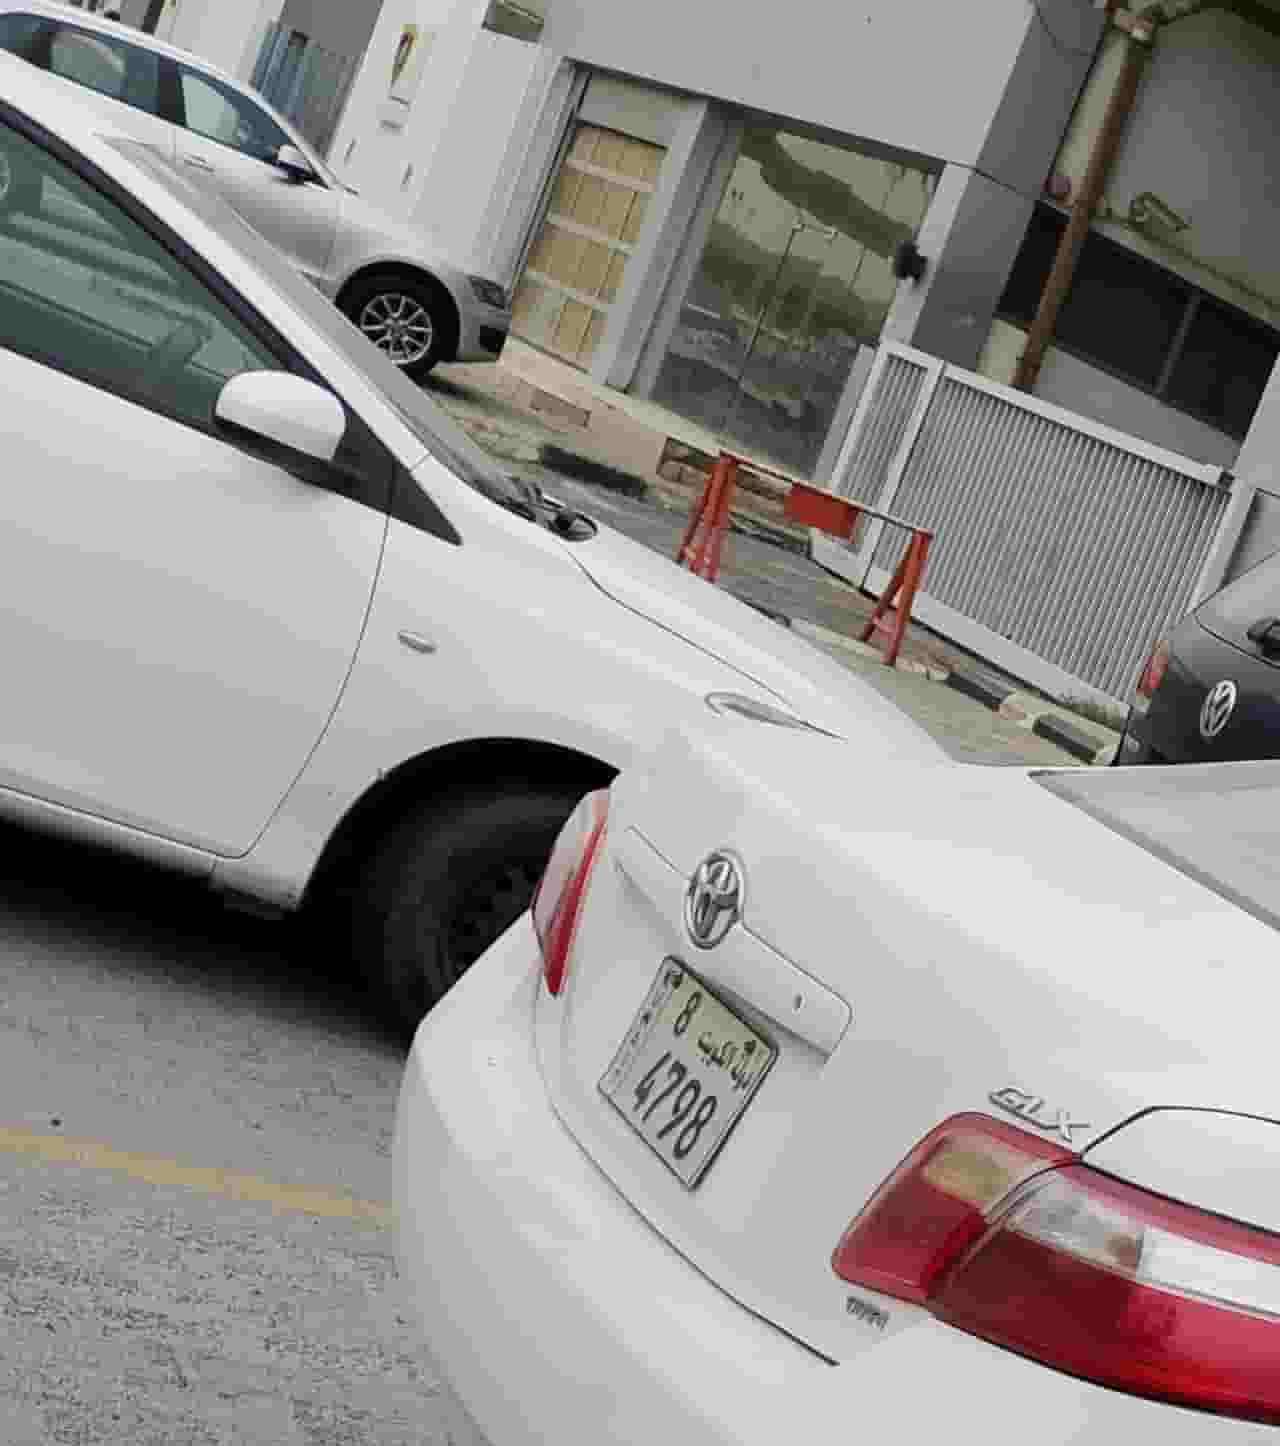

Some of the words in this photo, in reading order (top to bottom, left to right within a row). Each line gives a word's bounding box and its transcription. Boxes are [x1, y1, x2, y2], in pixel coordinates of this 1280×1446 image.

[672, 990, 704, 1038] 8
[633, 1050, 718, 1160] 4798
[987, 1086, 1093, 1143] GLX
